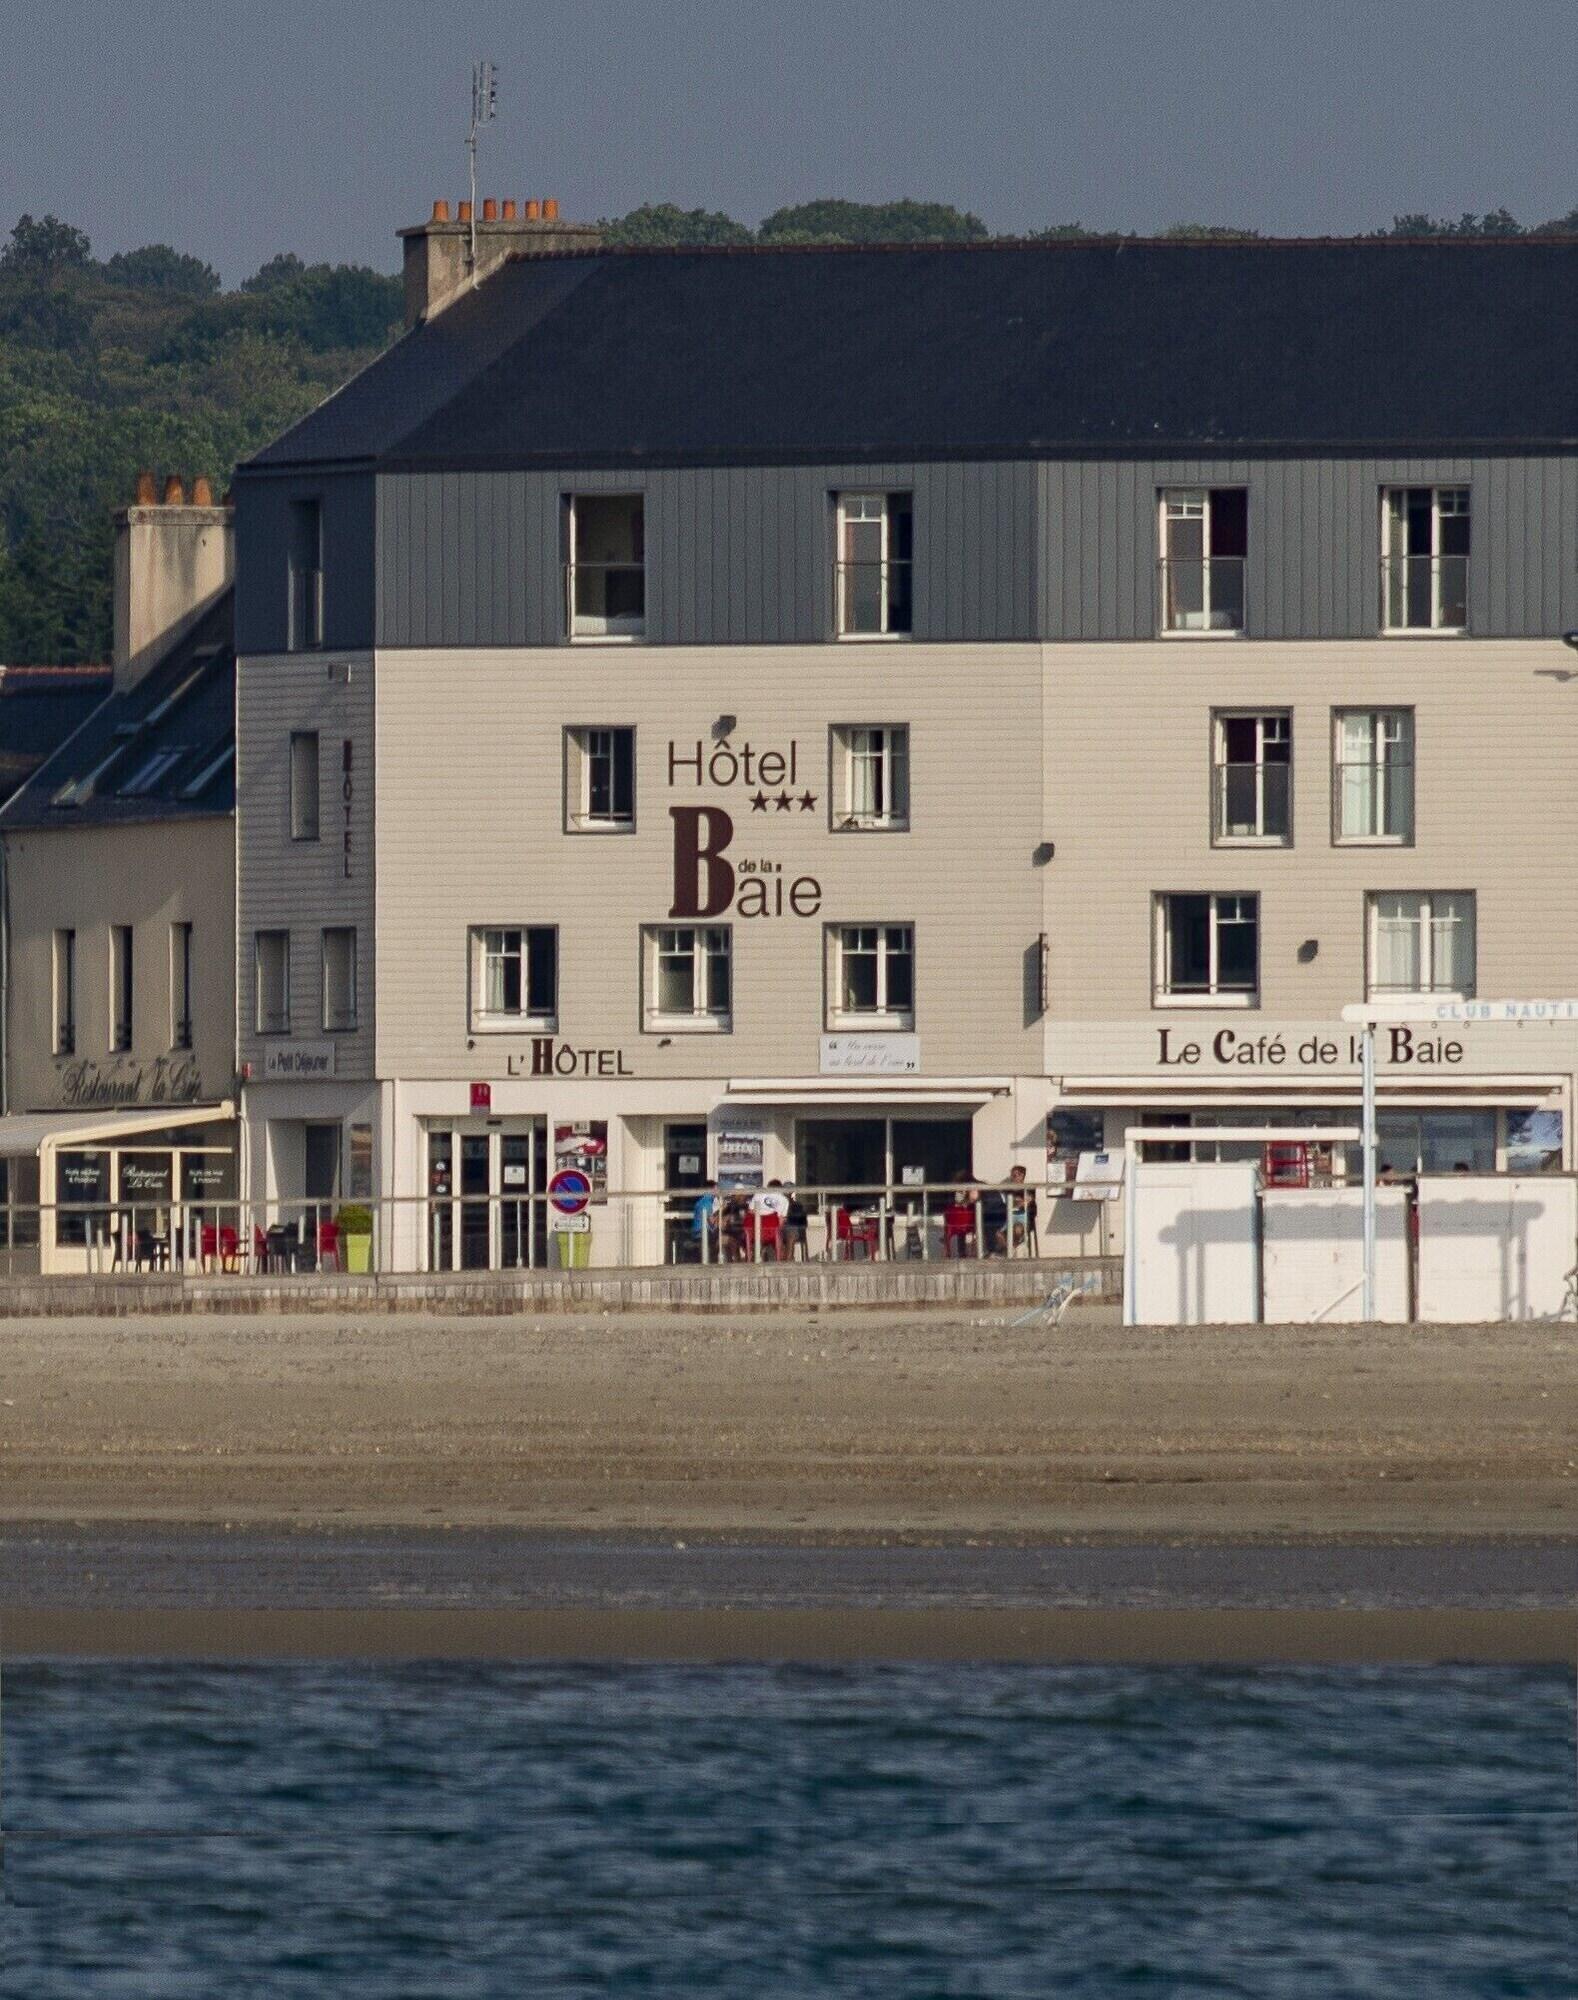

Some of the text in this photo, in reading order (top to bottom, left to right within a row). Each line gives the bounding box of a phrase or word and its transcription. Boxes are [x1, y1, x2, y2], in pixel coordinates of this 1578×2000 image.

[668, 739, 796, 786] Hôtel
[668, 806, 822, 918] Baie
[738, 859, 772, 873] de la
[1436, 1004, 1491, 1019] CLUB
[1157, 1029, 1200, 1065] Le
[1213, 1028, 1286, 1065] Café
[1298, 1036, 1338, 1065] de
[1388, 1028, 1464, 1064] Baie
